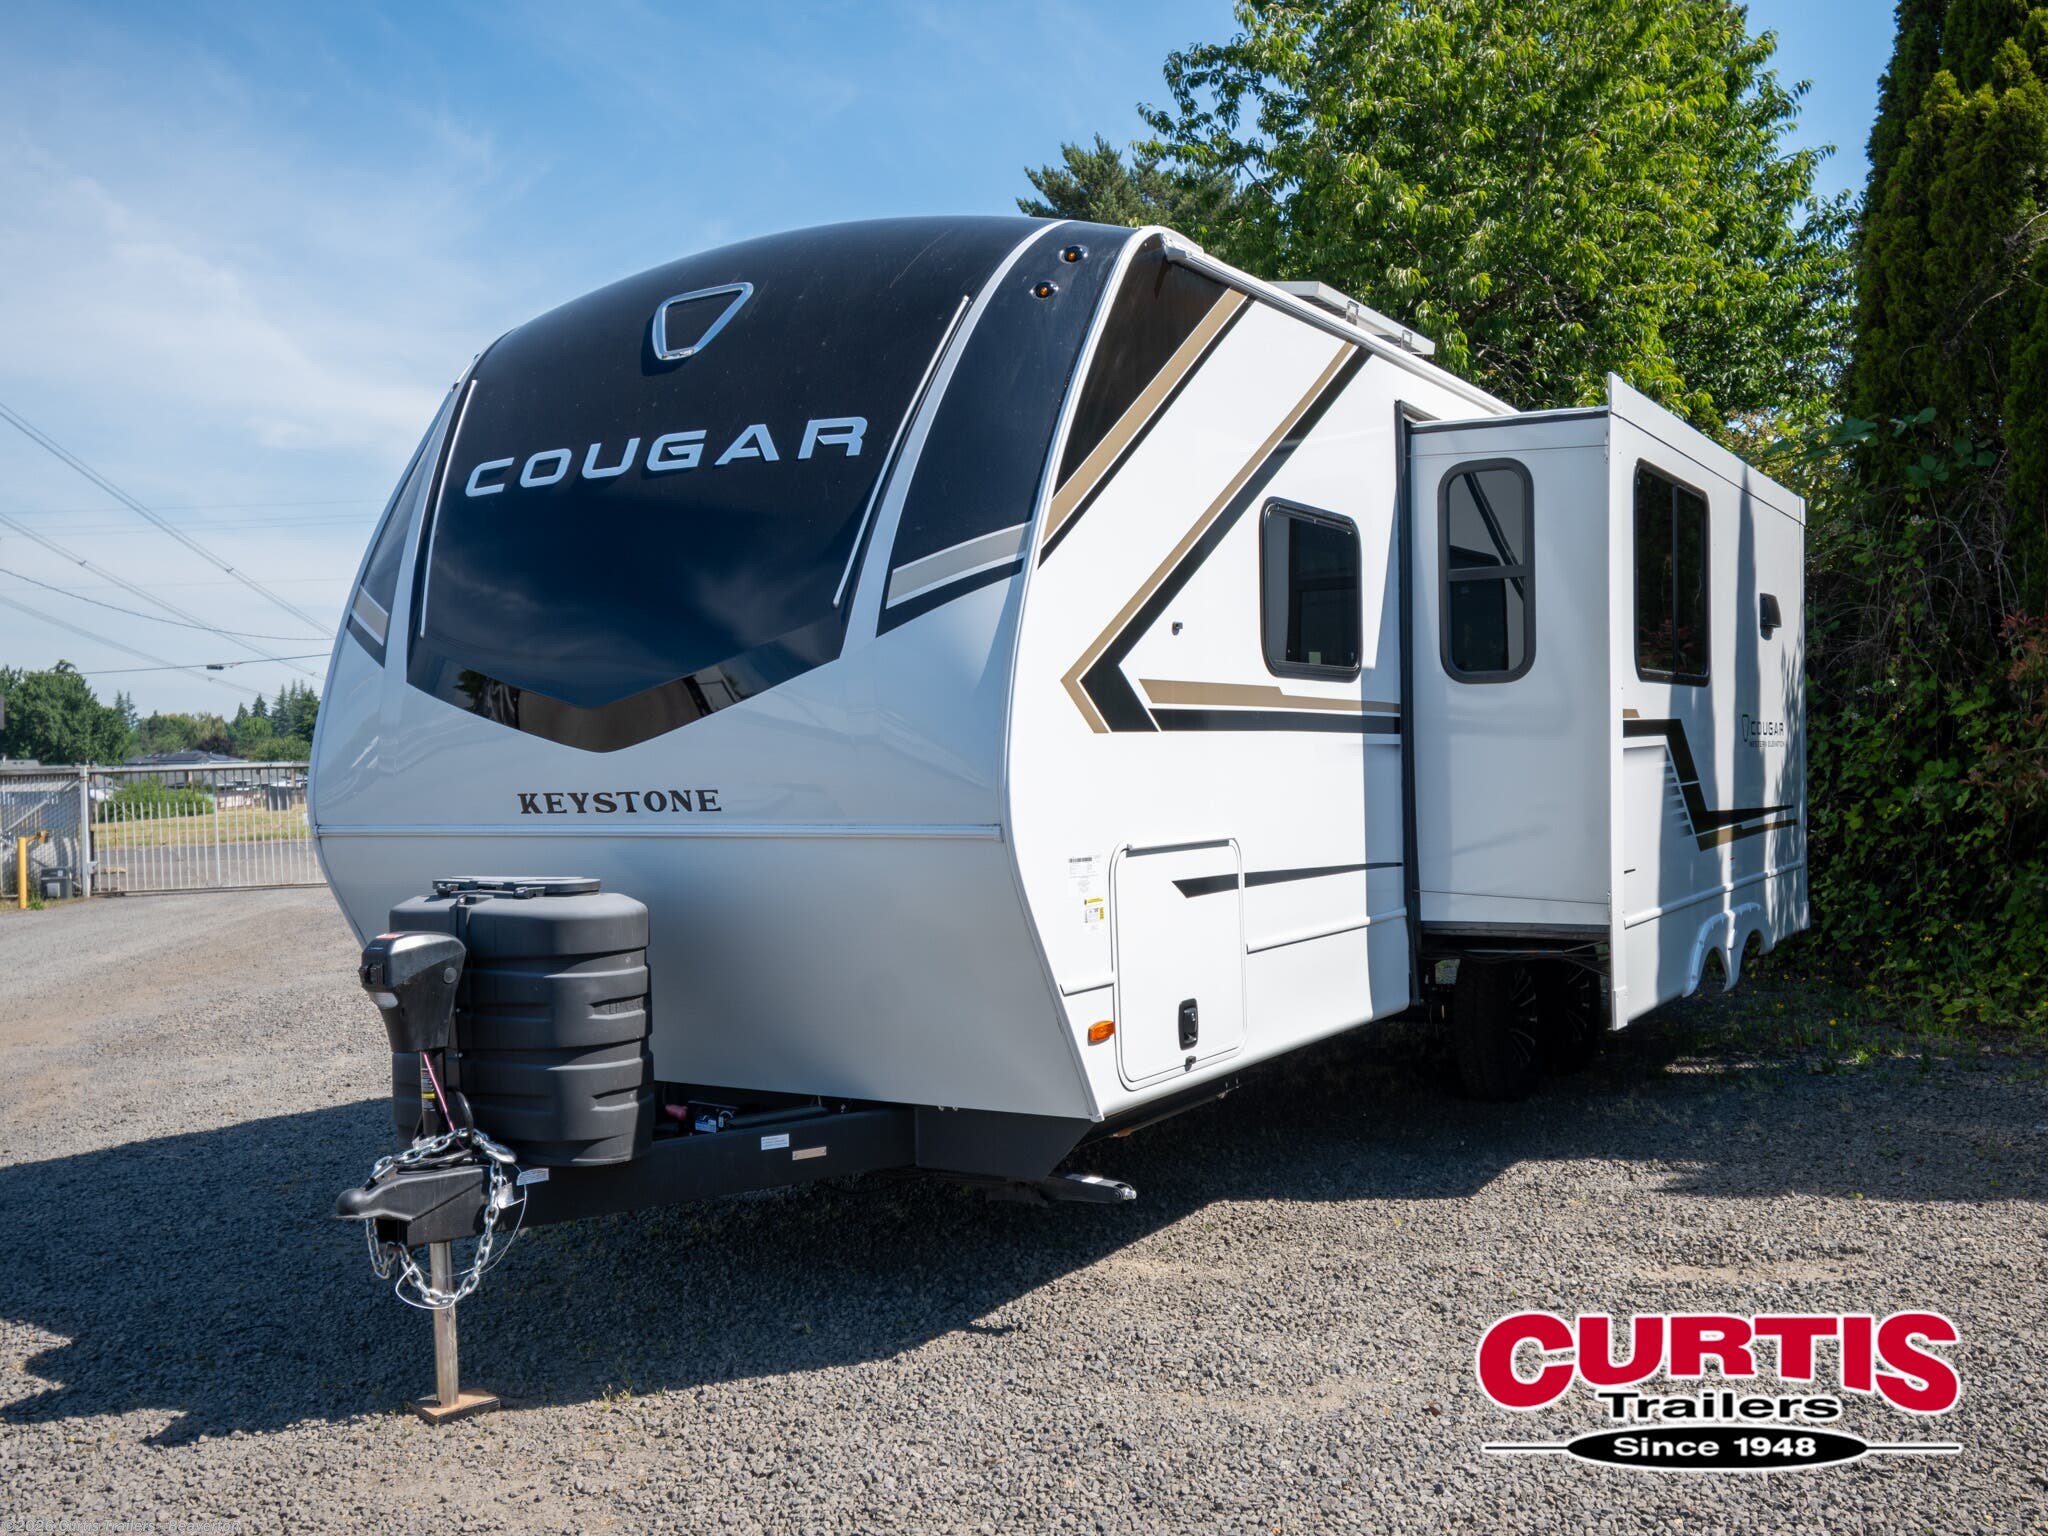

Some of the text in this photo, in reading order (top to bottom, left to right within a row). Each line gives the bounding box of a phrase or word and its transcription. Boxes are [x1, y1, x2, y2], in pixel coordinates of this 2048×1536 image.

[465, 416, 868, 498] COUGAR
[1751, 721, 1784, 736] COUGAR
[517, 789, 722, 815] KEYSTONE
